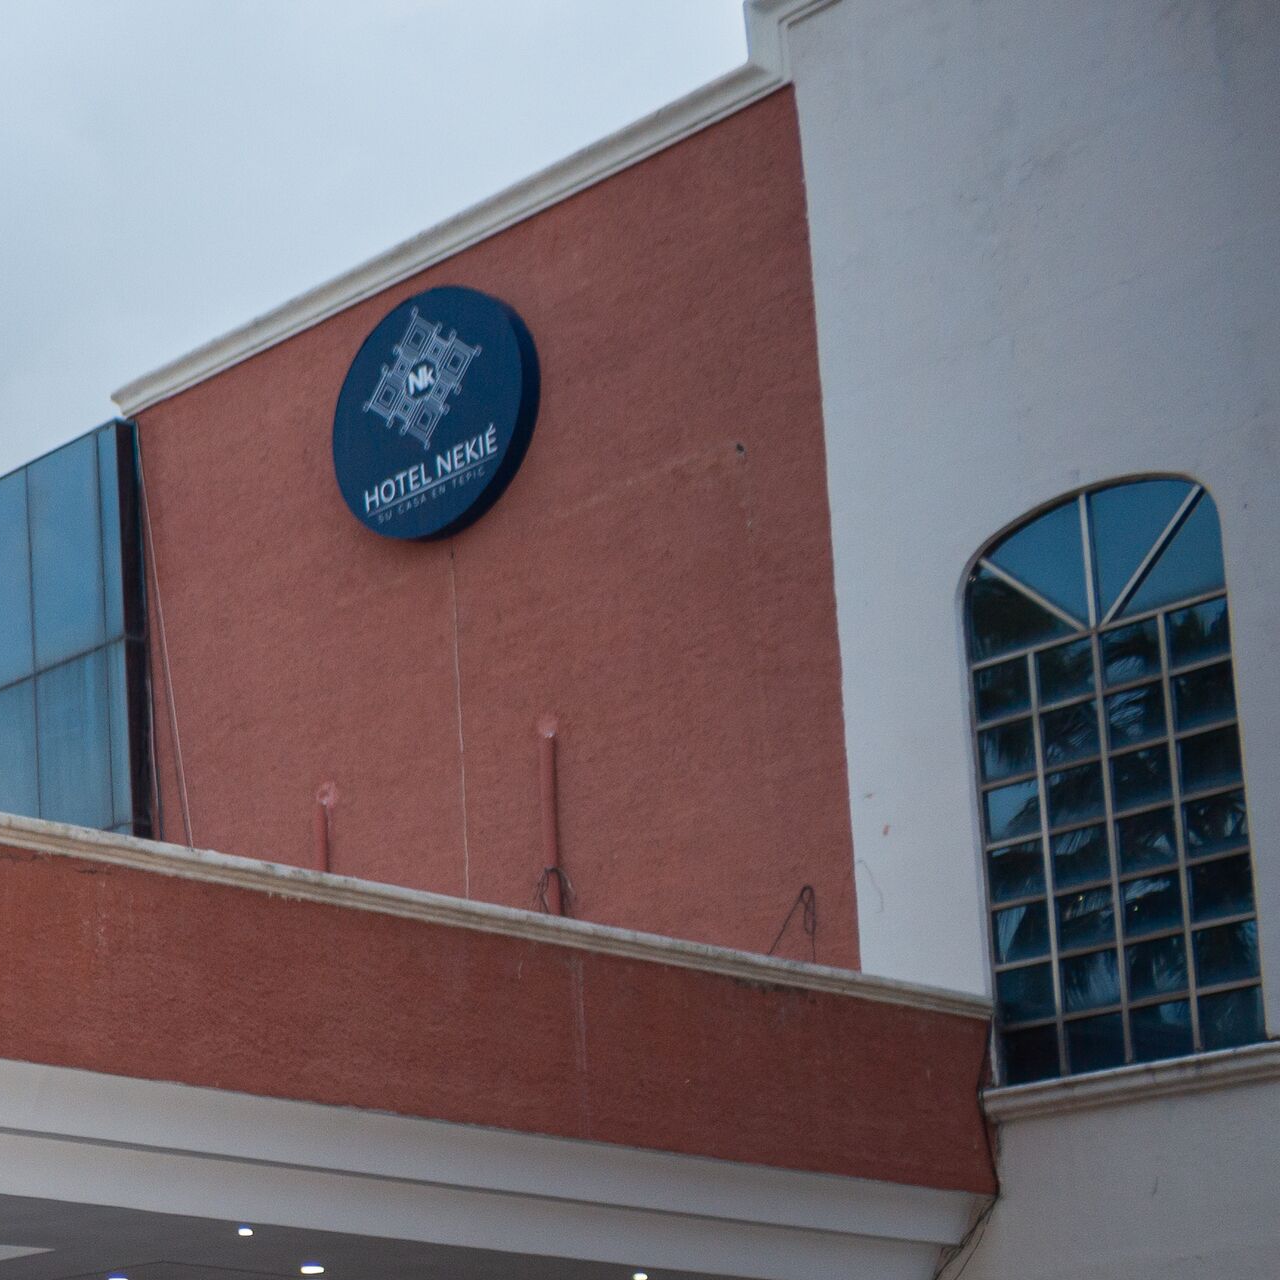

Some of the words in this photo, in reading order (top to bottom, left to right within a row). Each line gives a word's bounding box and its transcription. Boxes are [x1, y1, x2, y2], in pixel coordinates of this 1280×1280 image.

[364, 462, 432, 513] HOTEL
[436, 424, 498, 476] NEKIÉ
[398, 492, 427, 515] CASA
[432, 485, 446, 498] EN
[452, 467, 486, 488] TEPIC
